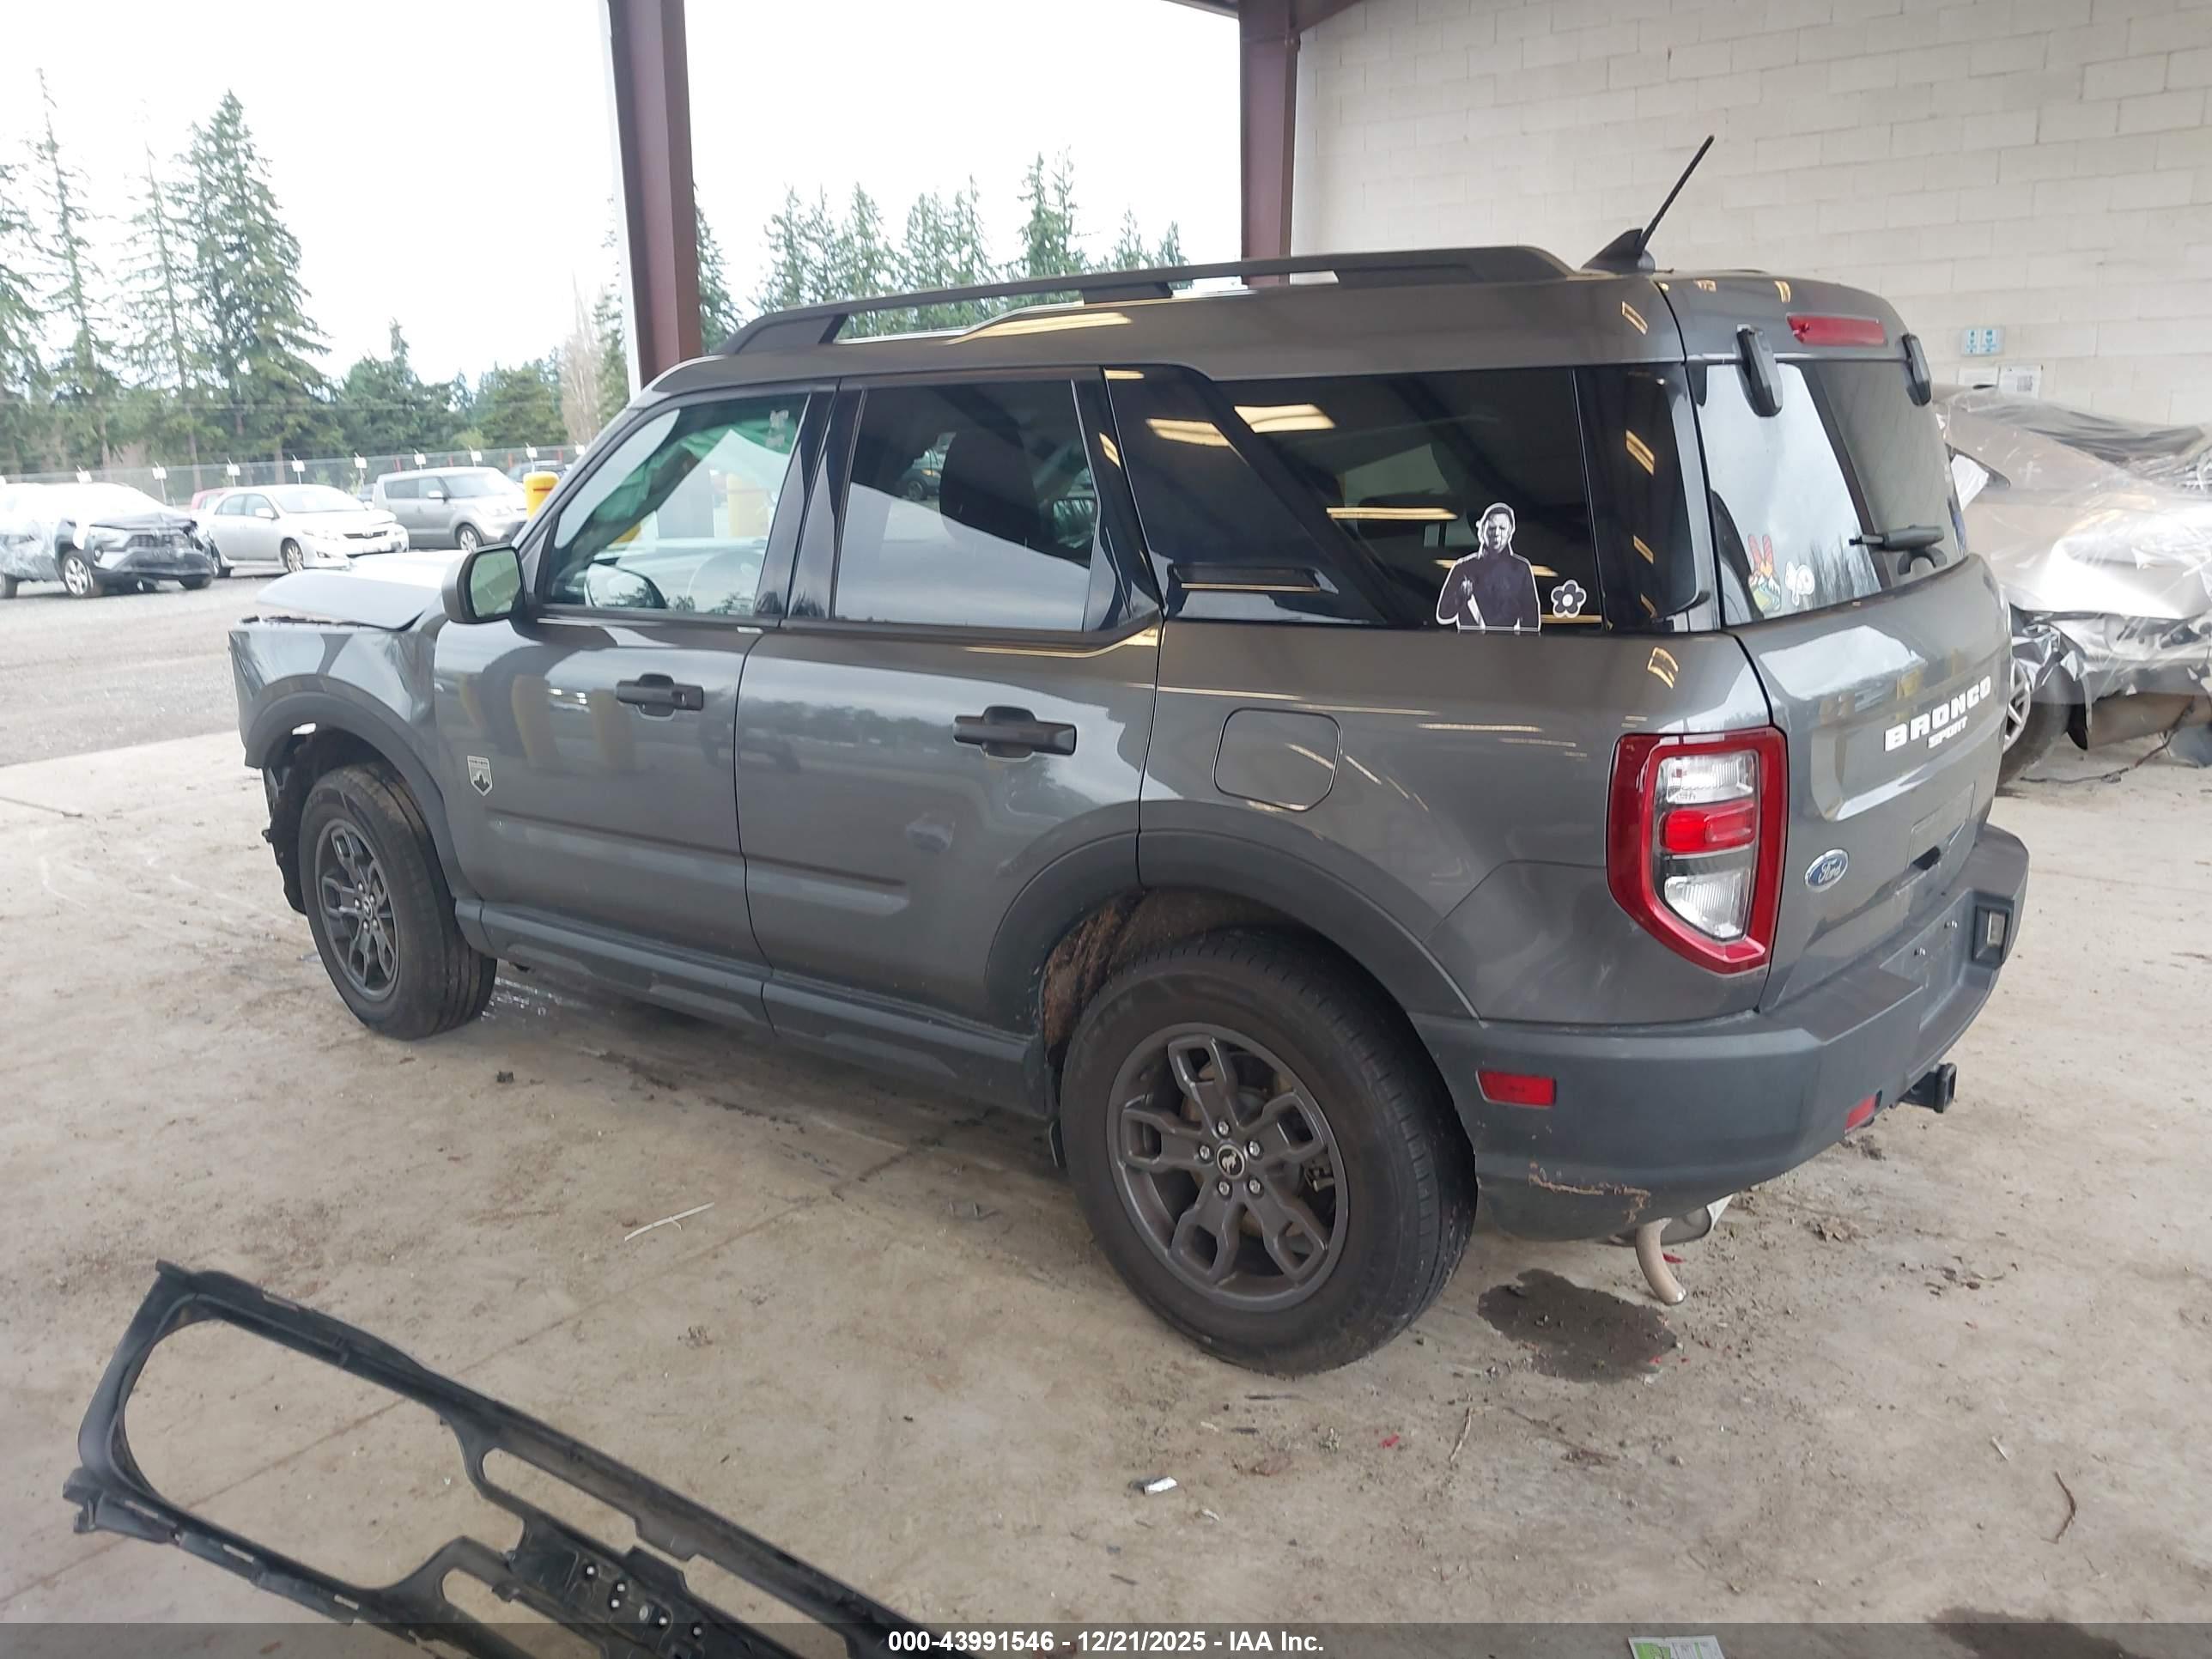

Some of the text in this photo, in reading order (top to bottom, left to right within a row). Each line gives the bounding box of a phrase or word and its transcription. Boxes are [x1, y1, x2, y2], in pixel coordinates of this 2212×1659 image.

[1884, 675, 1991, 752] BRONCO
[1927, 715, 1968, 749] SPORT
[1815, 857, 1844, 885] Ford
